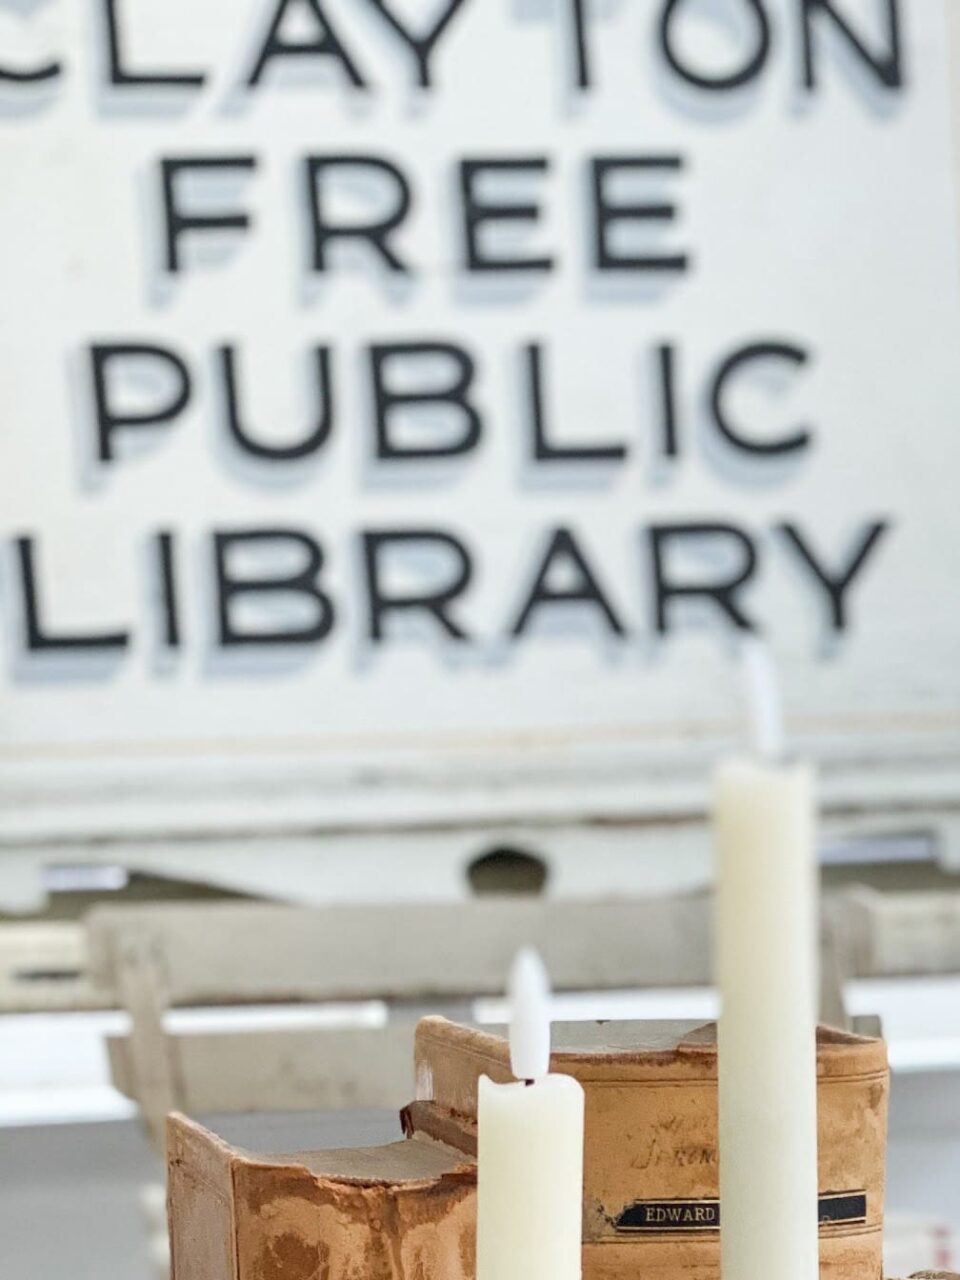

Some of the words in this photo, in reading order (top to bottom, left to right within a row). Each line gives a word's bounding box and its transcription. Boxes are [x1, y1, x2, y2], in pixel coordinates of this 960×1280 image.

[160, 154, 690, 274] FREE
[90, 341, 812, 463] PUBLIC
[16, 519, 888, 650] LIBRARY
[645, 1206, 716, 1222] EDWARD
